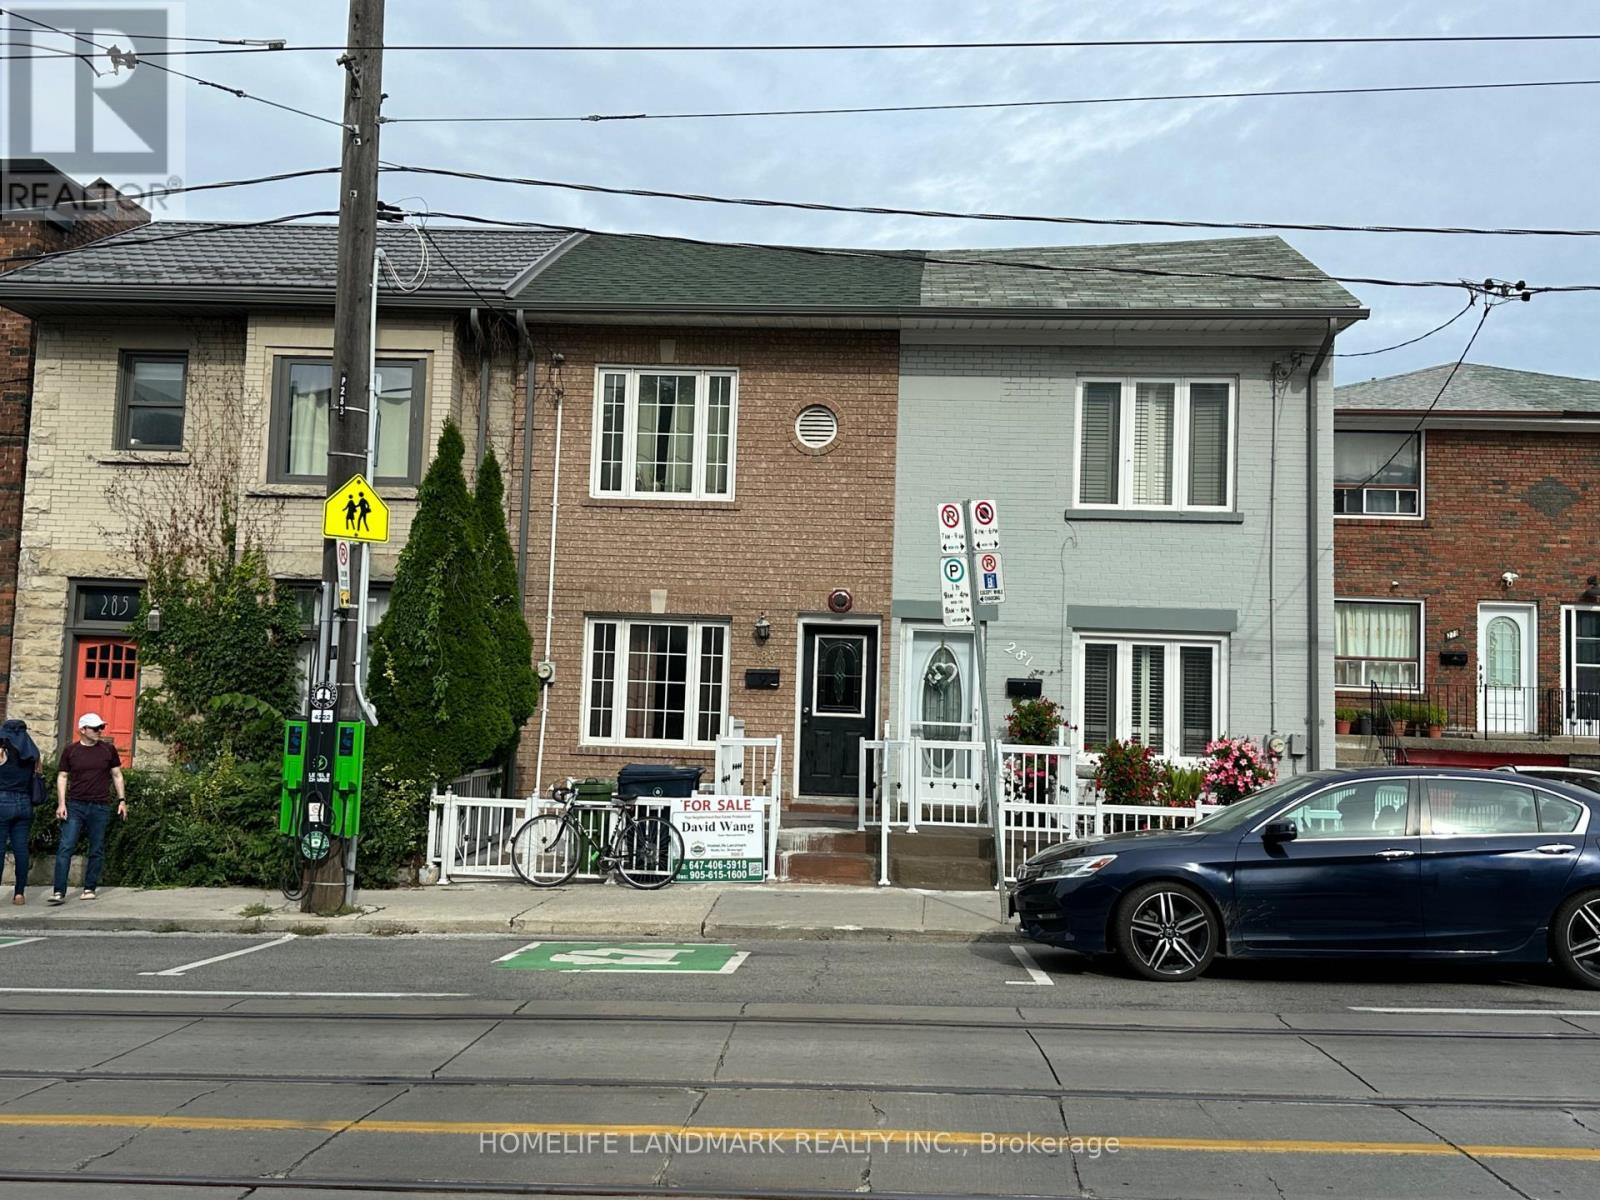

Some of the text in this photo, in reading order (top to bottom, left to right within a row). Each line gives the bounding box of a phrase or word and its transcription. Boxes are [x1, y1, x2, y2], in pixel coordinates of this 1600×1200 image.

[100, 594, 129, 616] 285
[1003, 641, 1034, 667] 281
[683, 799, 752, 811] FOR SALE
[682, 821, 754, 834] David Wang
[689, 860, 747, 870] 647-406-5918
[689, 870, 747, 880] 905-615-1600
